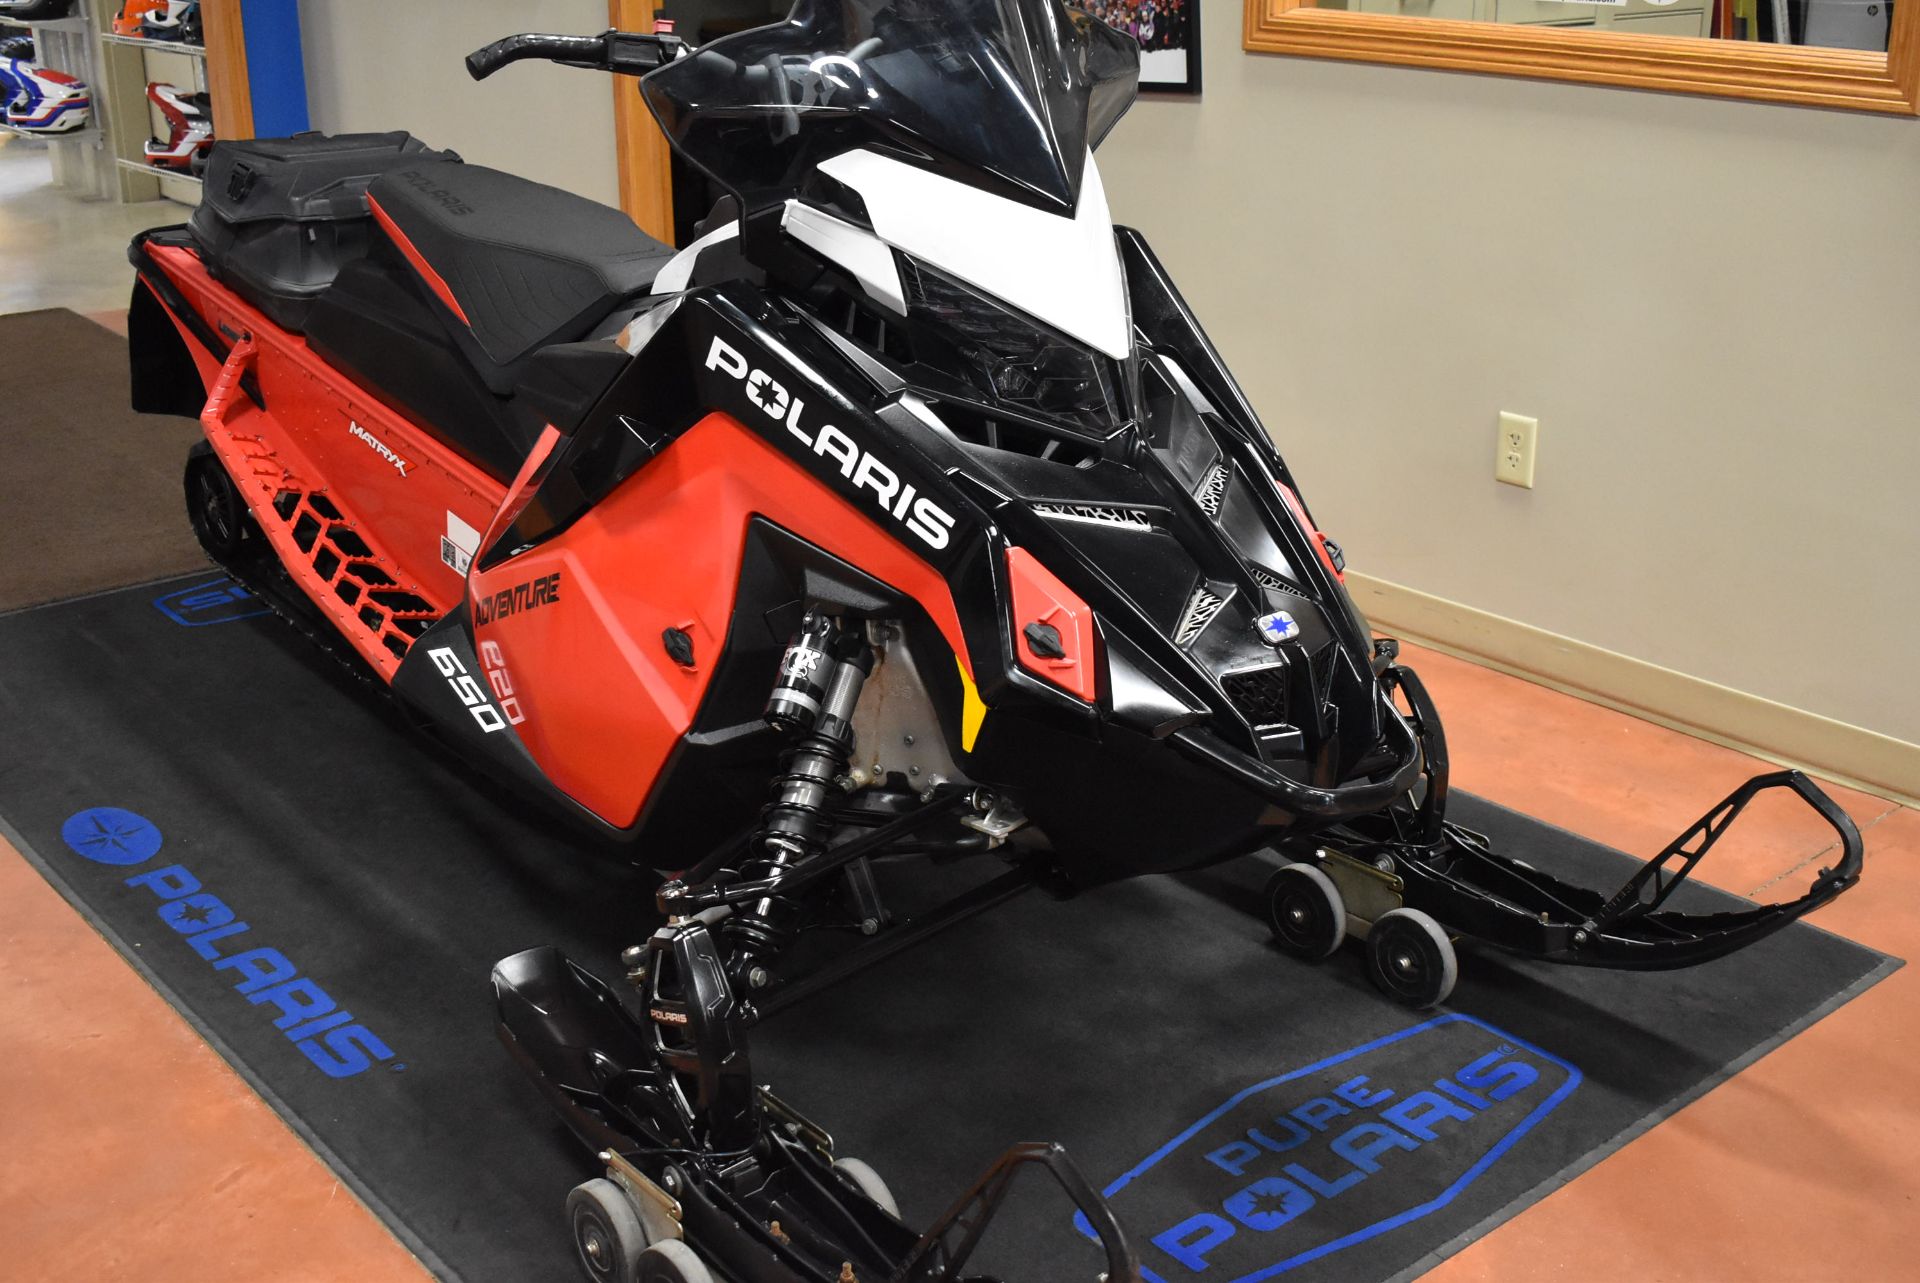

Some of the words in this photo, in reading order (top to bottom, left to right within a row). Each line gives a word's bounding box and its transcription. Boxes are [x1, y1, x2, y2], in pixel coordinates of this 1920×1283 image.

[401, 171, 475, 216] POLARIS
[349, 420, 407, 477] MATRYX
[704, 335, 956, 550] POLARIS
[475, 572, 561, 628] ADVENTURE
[427, 646, 507, 733] 650
[124, 863, 396, 1078] POLARIS
[650, 1009, 688, 1023] POLARIS
[1150, 1049, 1540, 1273] POLARIS
[1203, 1074, 1396, 1176] PURE
